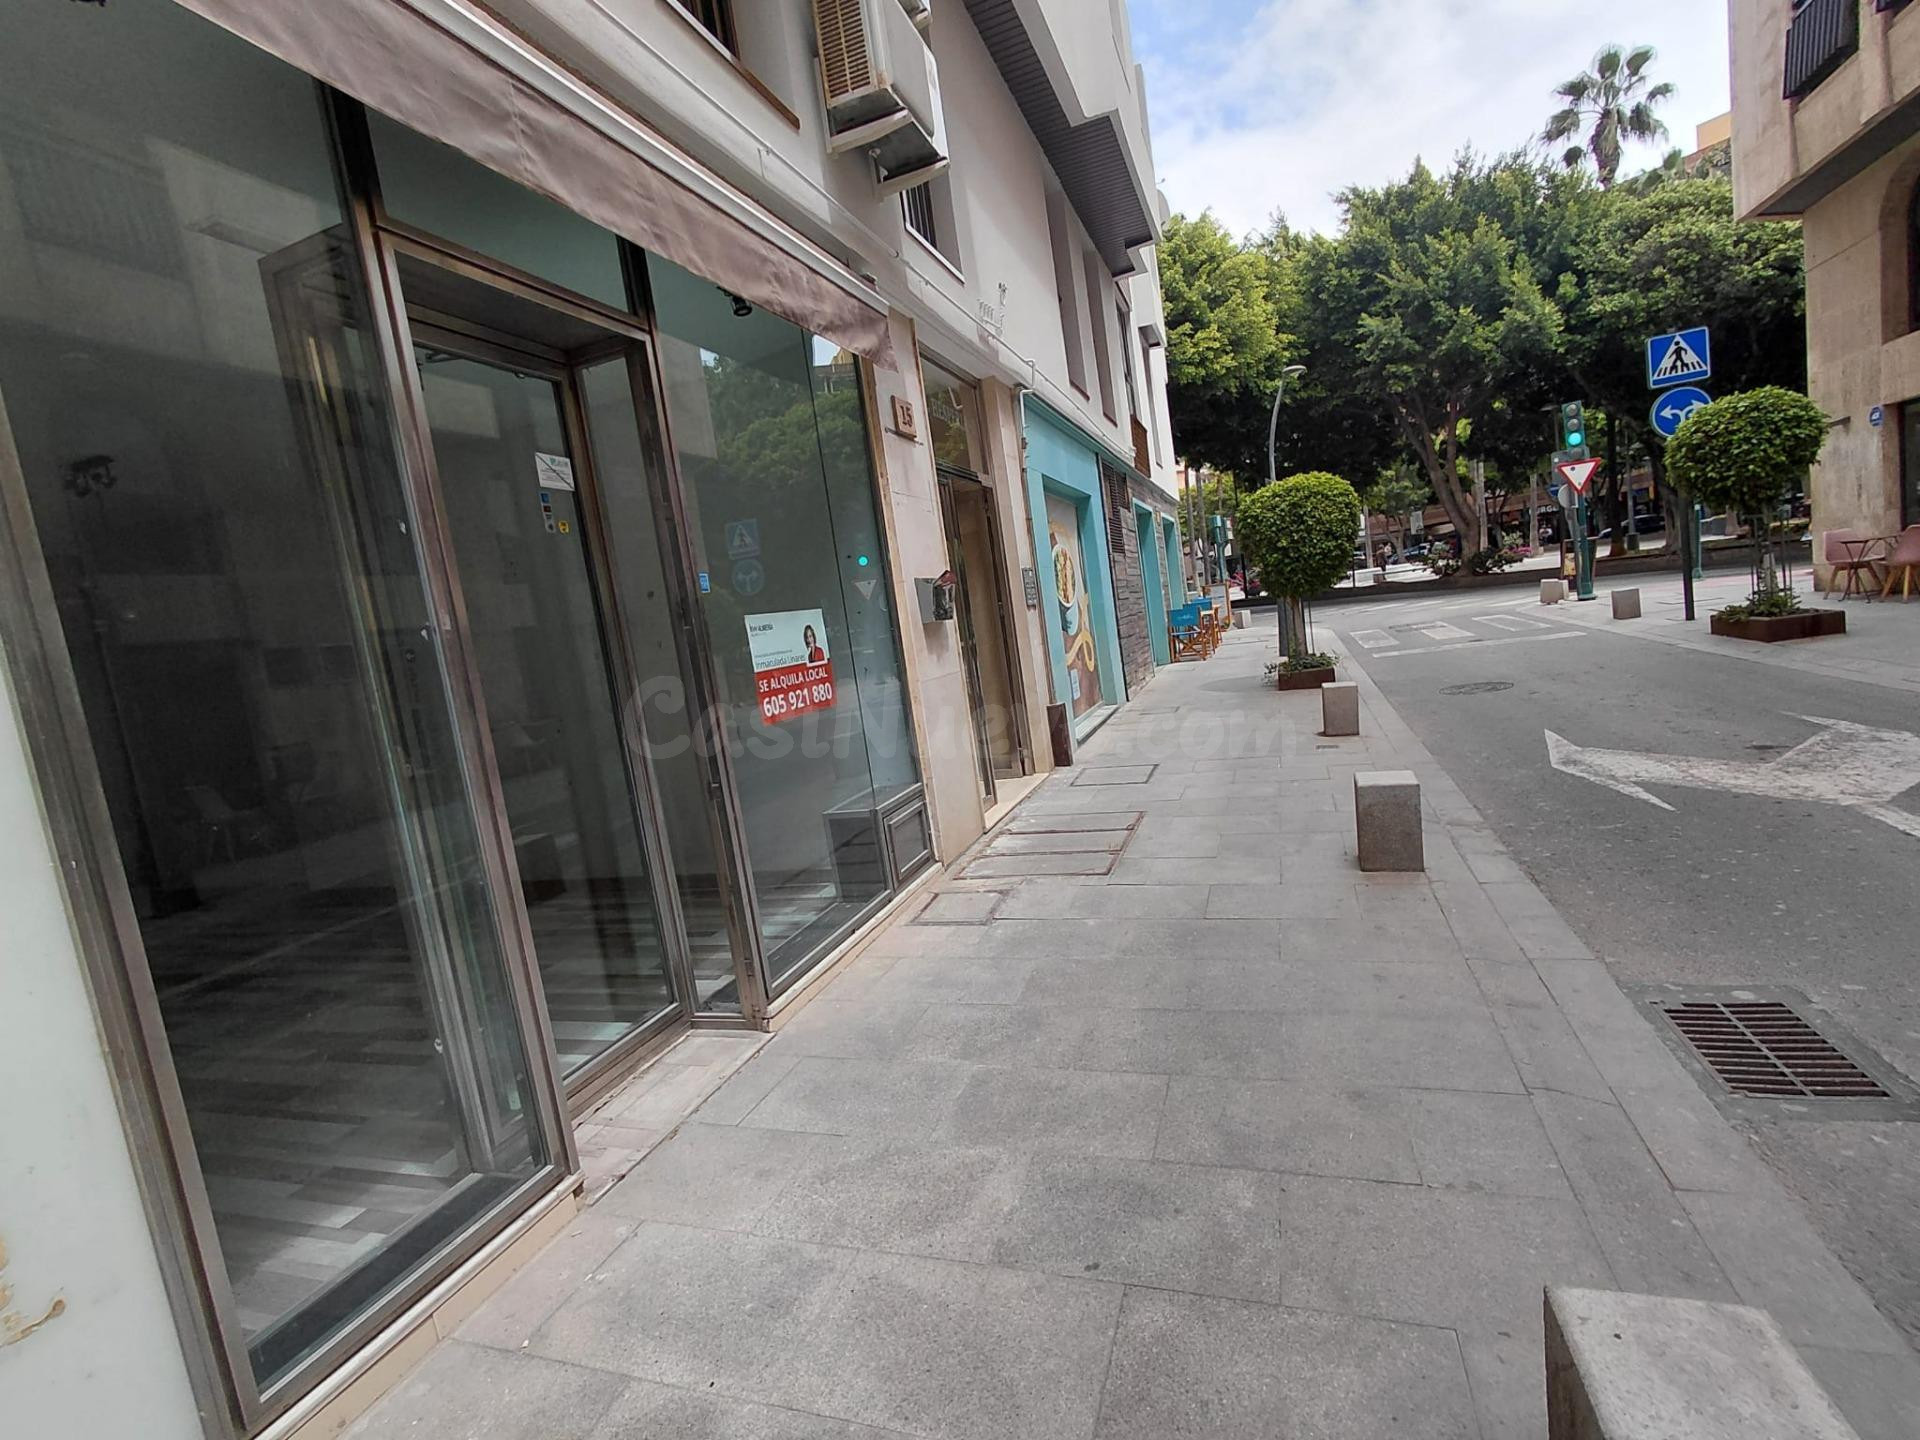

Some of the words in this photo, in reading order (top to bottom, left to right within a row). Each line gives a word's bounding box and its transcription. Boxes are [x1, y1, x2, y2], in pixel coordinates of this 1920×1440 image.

[899, 405, 913, 427] 15
[759, 679, 769, 692] SE
[770, 672, 805, 689] ALQUILA
[805, 666, 828, 682] LOCAL
[763, 693, 787, 717] 605
[788, 687, 810, 711] 921
[812, 682, 833, 703] 880
